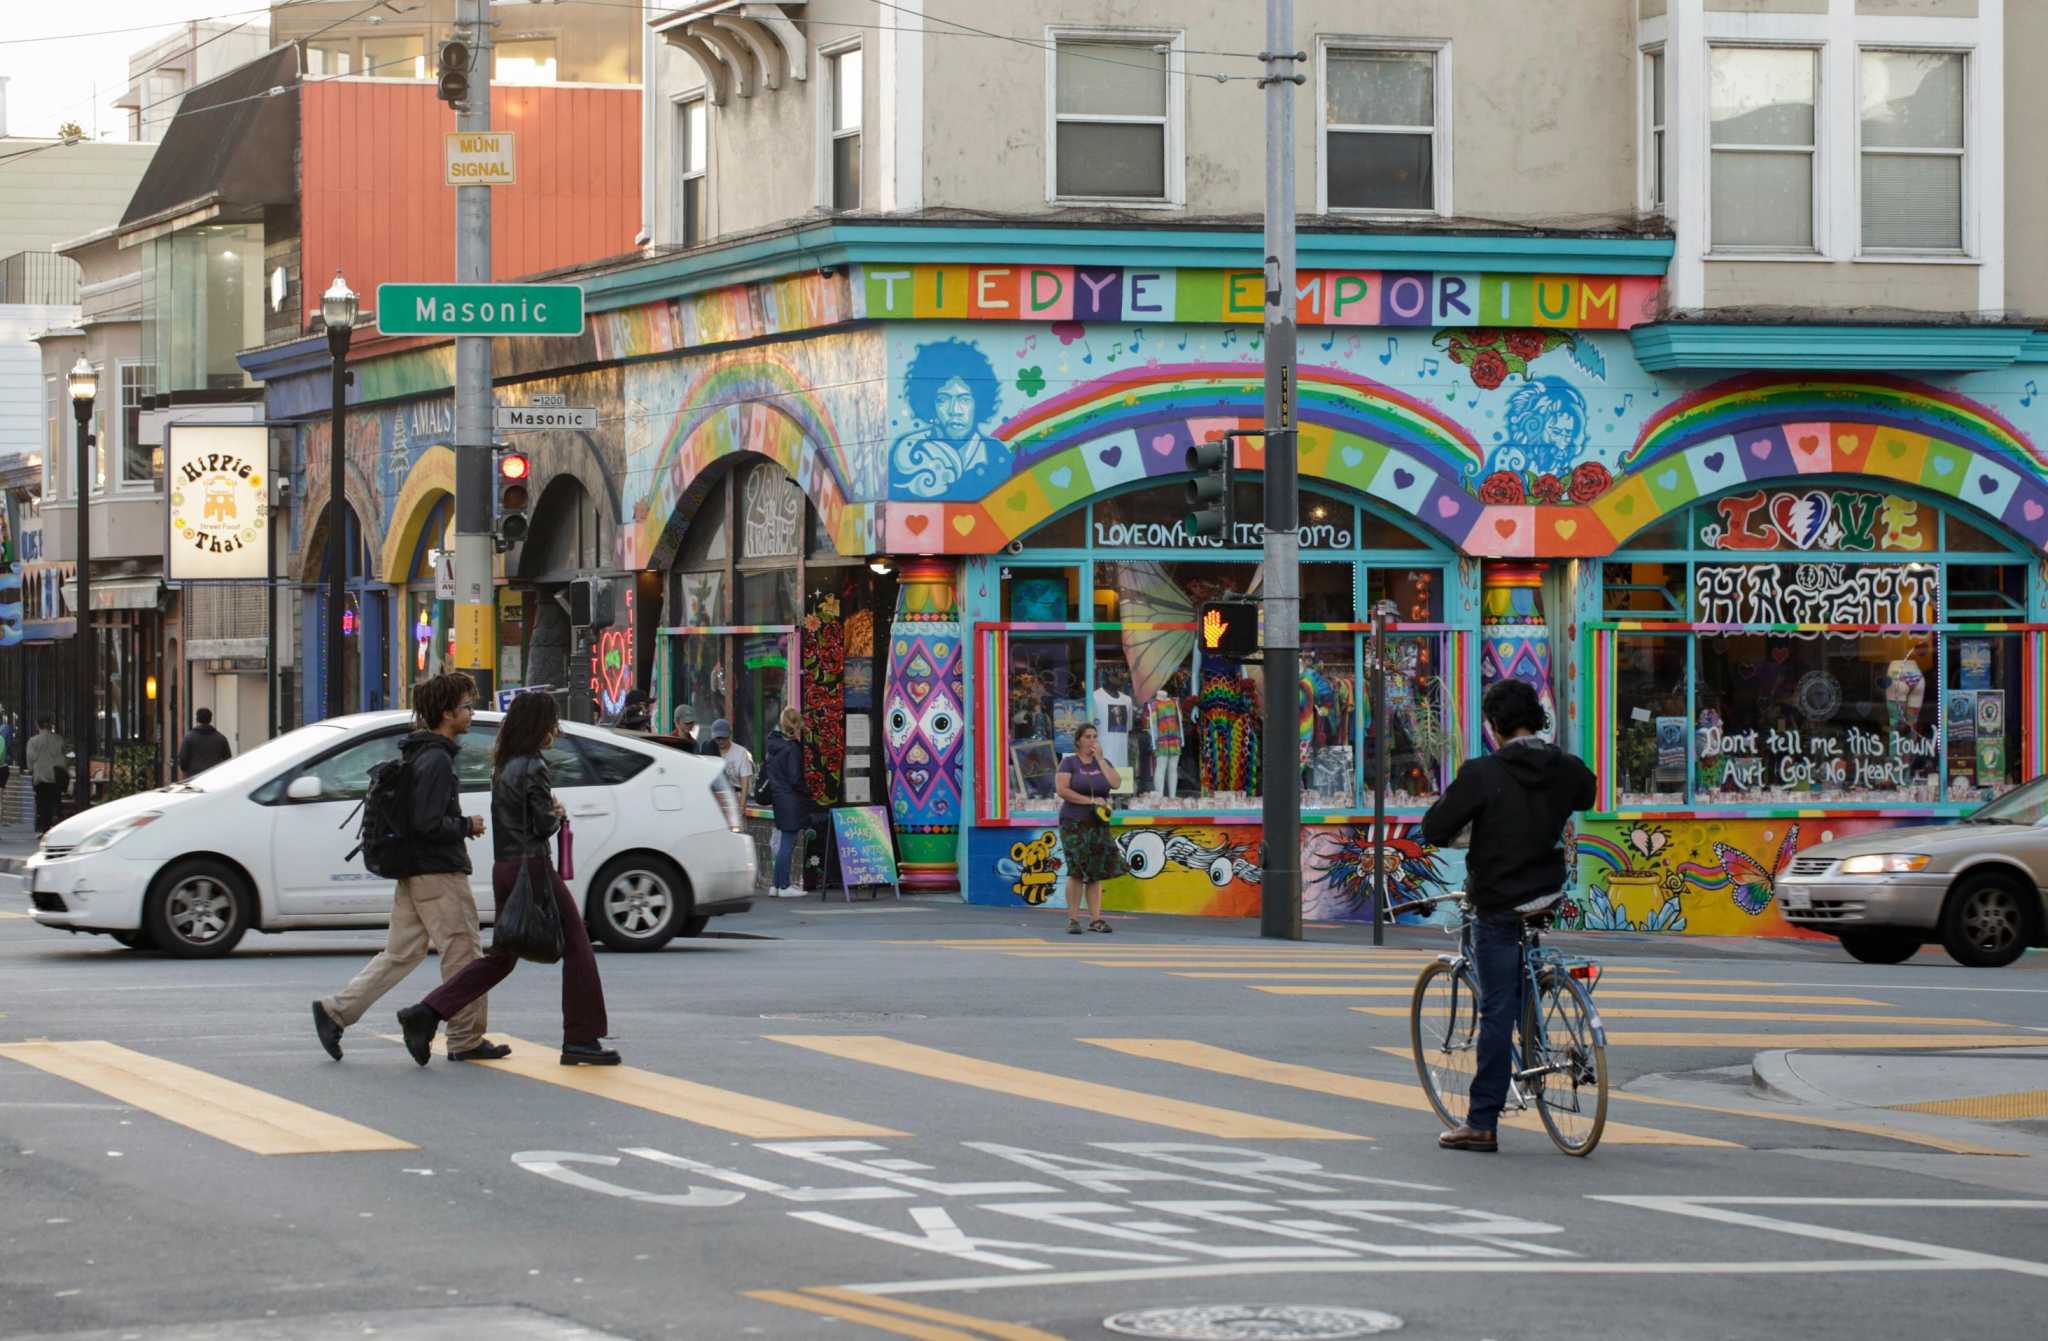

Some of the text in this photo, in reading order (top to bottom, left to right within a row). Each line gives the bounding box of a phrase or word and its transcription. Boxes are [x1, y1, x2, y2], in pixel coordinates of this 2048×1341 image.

[460, 139, 500, 153] MUNI
[451, 162, 510, 177] SIGNAL
[415, 297, 547, 323] Masonic
[1229, 273, 1617, 320] EMPORIUM
[511, 412, 582, 425] Masonic
[195, 531, 243, 553] Thai
[1796, 564, 1845, 592] ON
[1697, 563, 1940, 640] HAIGHT
[1701, 726, 1758, 757] Don't
[1766, 728, 1802, 755] tell
[1811, 736, 1843, 757] me
[1847, 726, 1884, 756] this
[1780, 756, 1815, 790] Got
[1825, 758, 1846, 784] No
[510, 1141, 1454, 1206] CLEAR
[786, 1200, 1583, 1271] KEEP
